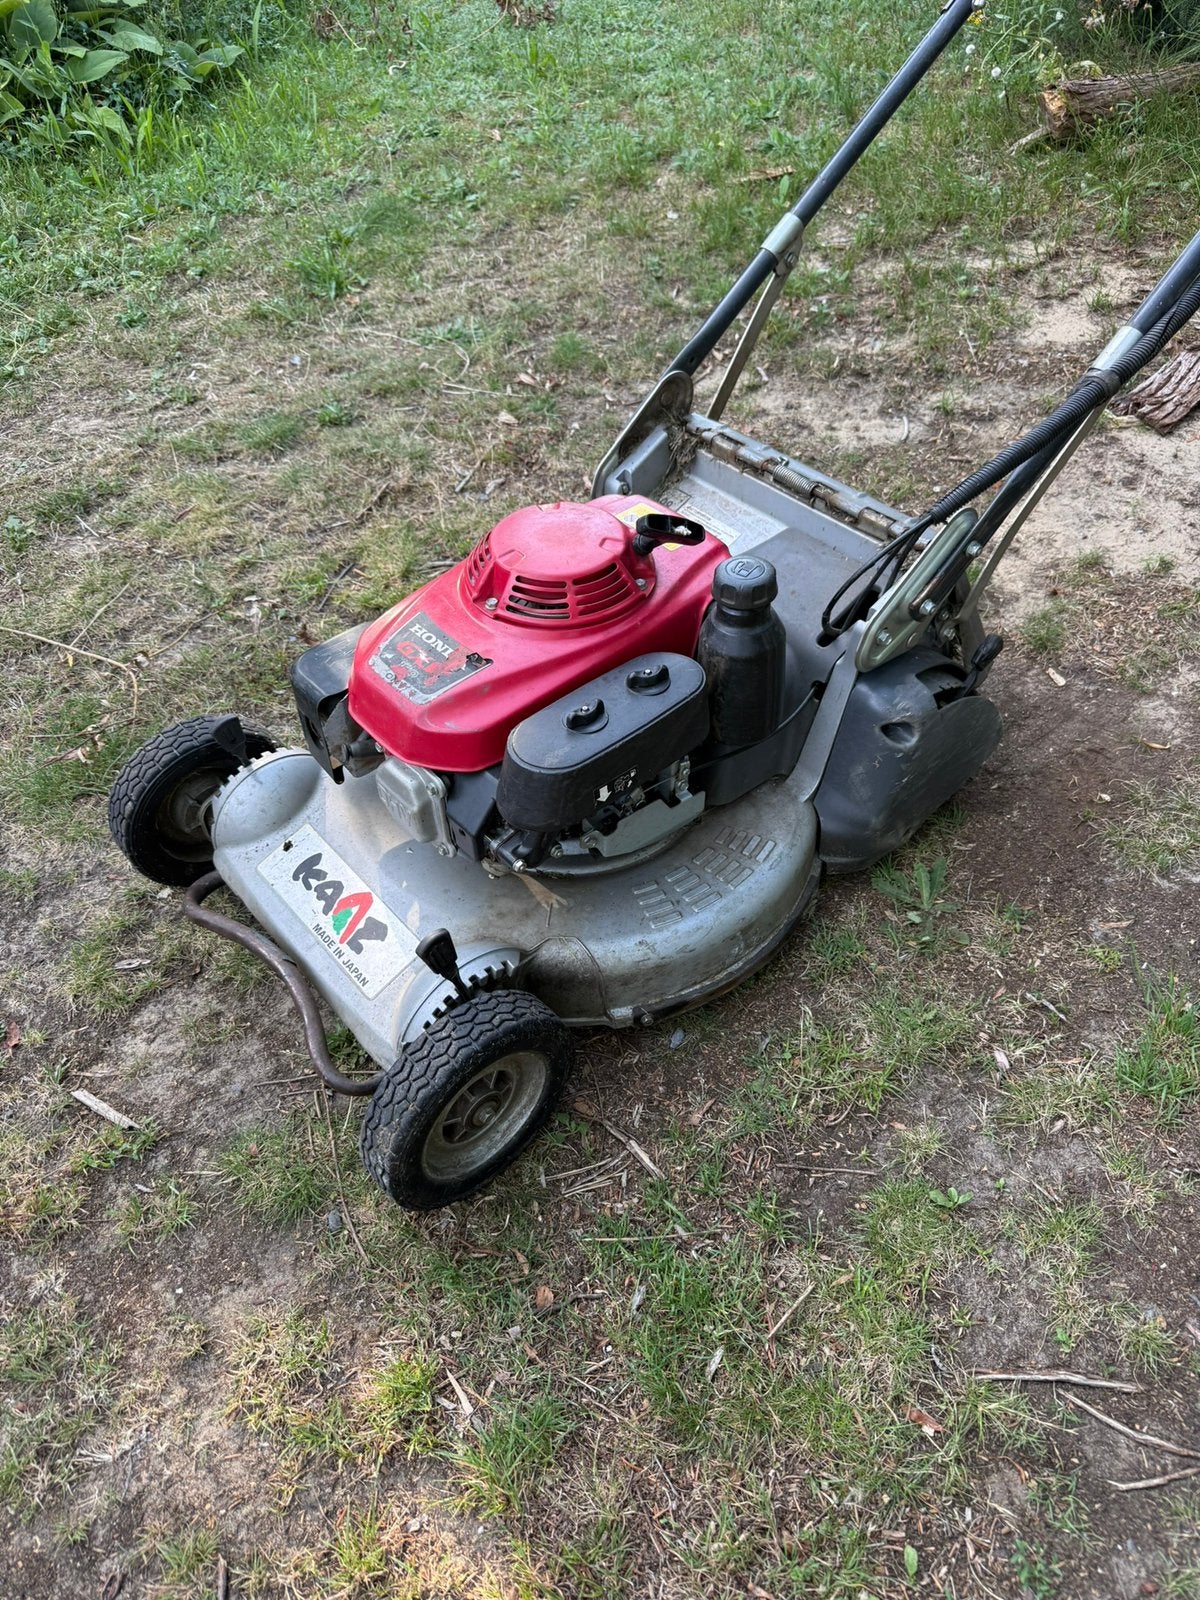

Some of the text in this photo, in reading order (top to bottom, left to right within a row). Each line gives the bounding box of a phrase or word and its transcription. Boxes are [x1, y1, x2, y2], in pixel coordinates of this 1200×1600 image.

[292, 852, 388, 955] KAAZ
[312, 923, 370, 987] MADE IN JAPAN
